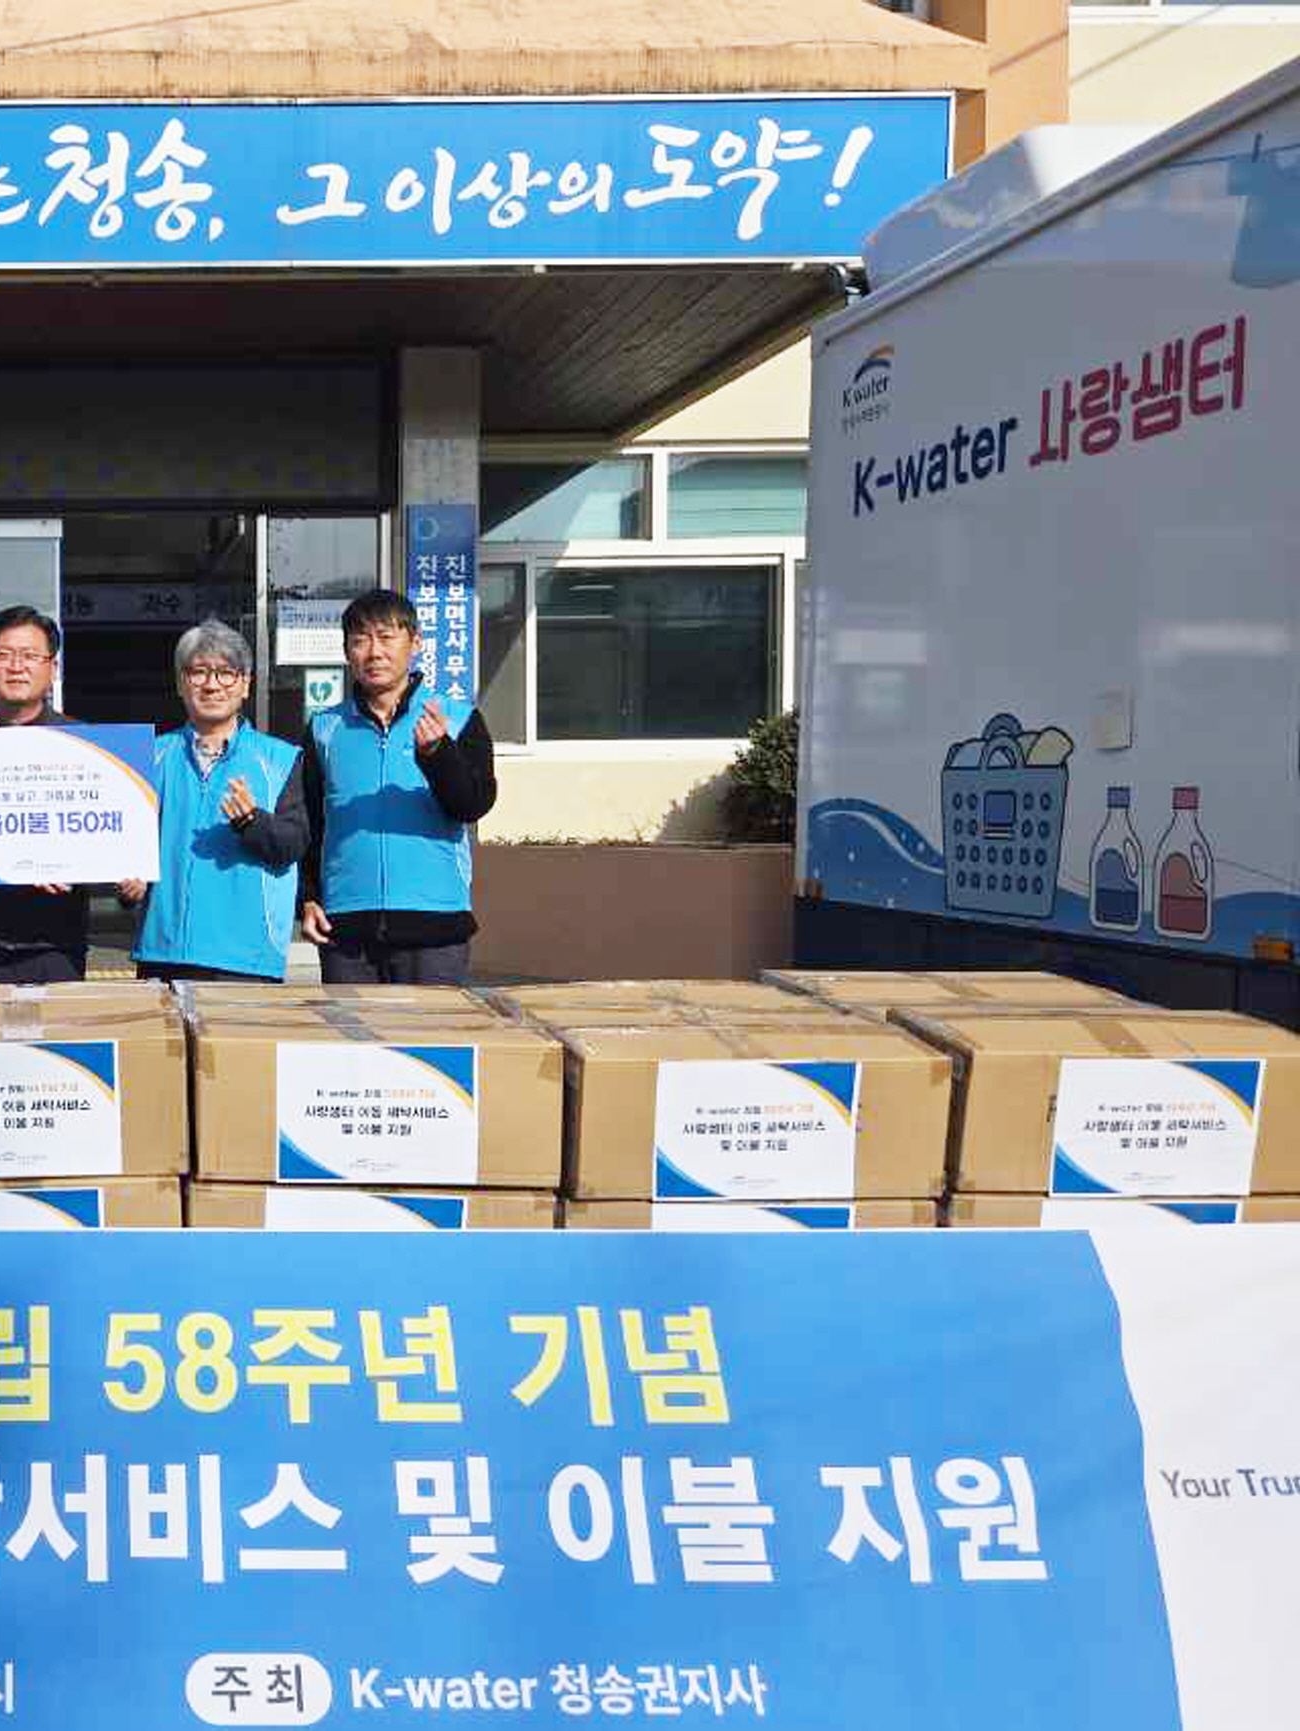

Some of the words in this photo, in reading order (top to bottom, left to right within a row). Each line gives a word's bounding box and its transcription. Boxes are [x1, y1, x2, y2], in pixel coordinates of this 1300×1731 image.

[38, 118, 224, 241] 청송,
[276, 163, 366, 225] 그
[384, 147, 614, 234] 이상의
[623, 117, 875, 241] 도약!
[853, 416, 1018, 517] K-water
[1028, 315, 1247, 467] 사랑샘터
[55, 811, 123, 834] 150채
[103, 1305, 463, 1424] 58주년
[508, 1305, 730, 1427] 기념
[394, 1455, 505, 1585] 및
[548, 1456, 775, 1585] 이불
[819, 1456, 1048, 1584] 지원
[1160, 1469, 1231, 1499] Your
[349, 1667, 538, 1710] K-water
[549, 1663, 768, 1716] 청송권지사
